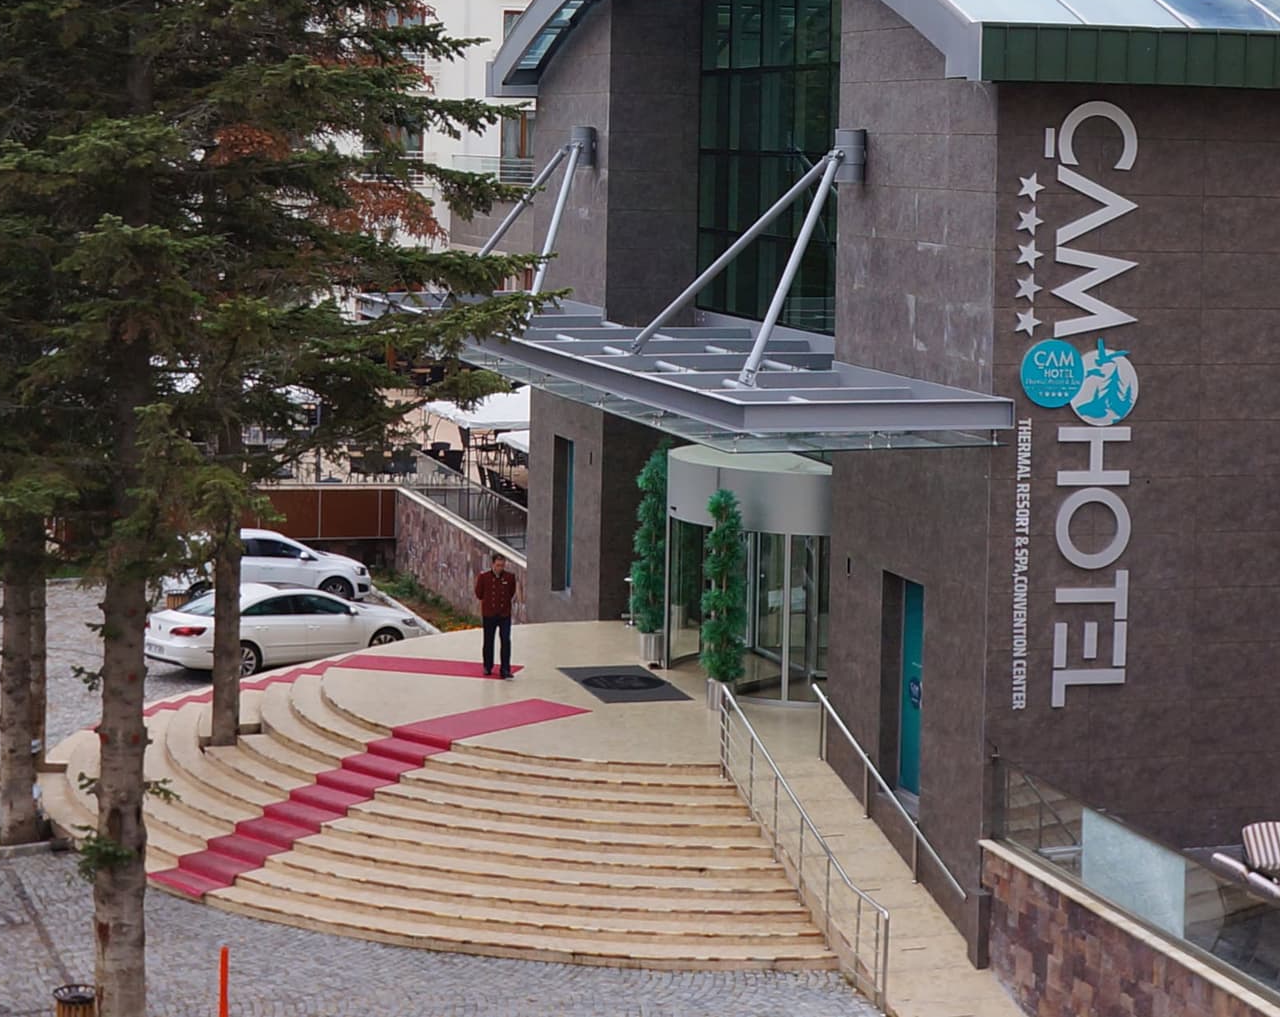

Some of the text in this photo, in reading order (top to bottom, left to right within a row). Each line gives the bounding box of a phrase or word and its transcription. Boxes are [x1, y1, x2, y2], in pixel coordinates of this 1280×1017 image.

[1044, 101, 1139, 338] ÇAM
[1033, 350, 1075, 370] ÇAM
[1043, 368, 1074, 379] HOTEL
[1016, 417, 1032, 481] THERMAL
[1015, 483, 1031, 535] RESORT
[1015, 536, 1030, 547] &
[1051, 426, 1131, 708] HOTEL
[1012, 659, 1027, 710] CENTER
